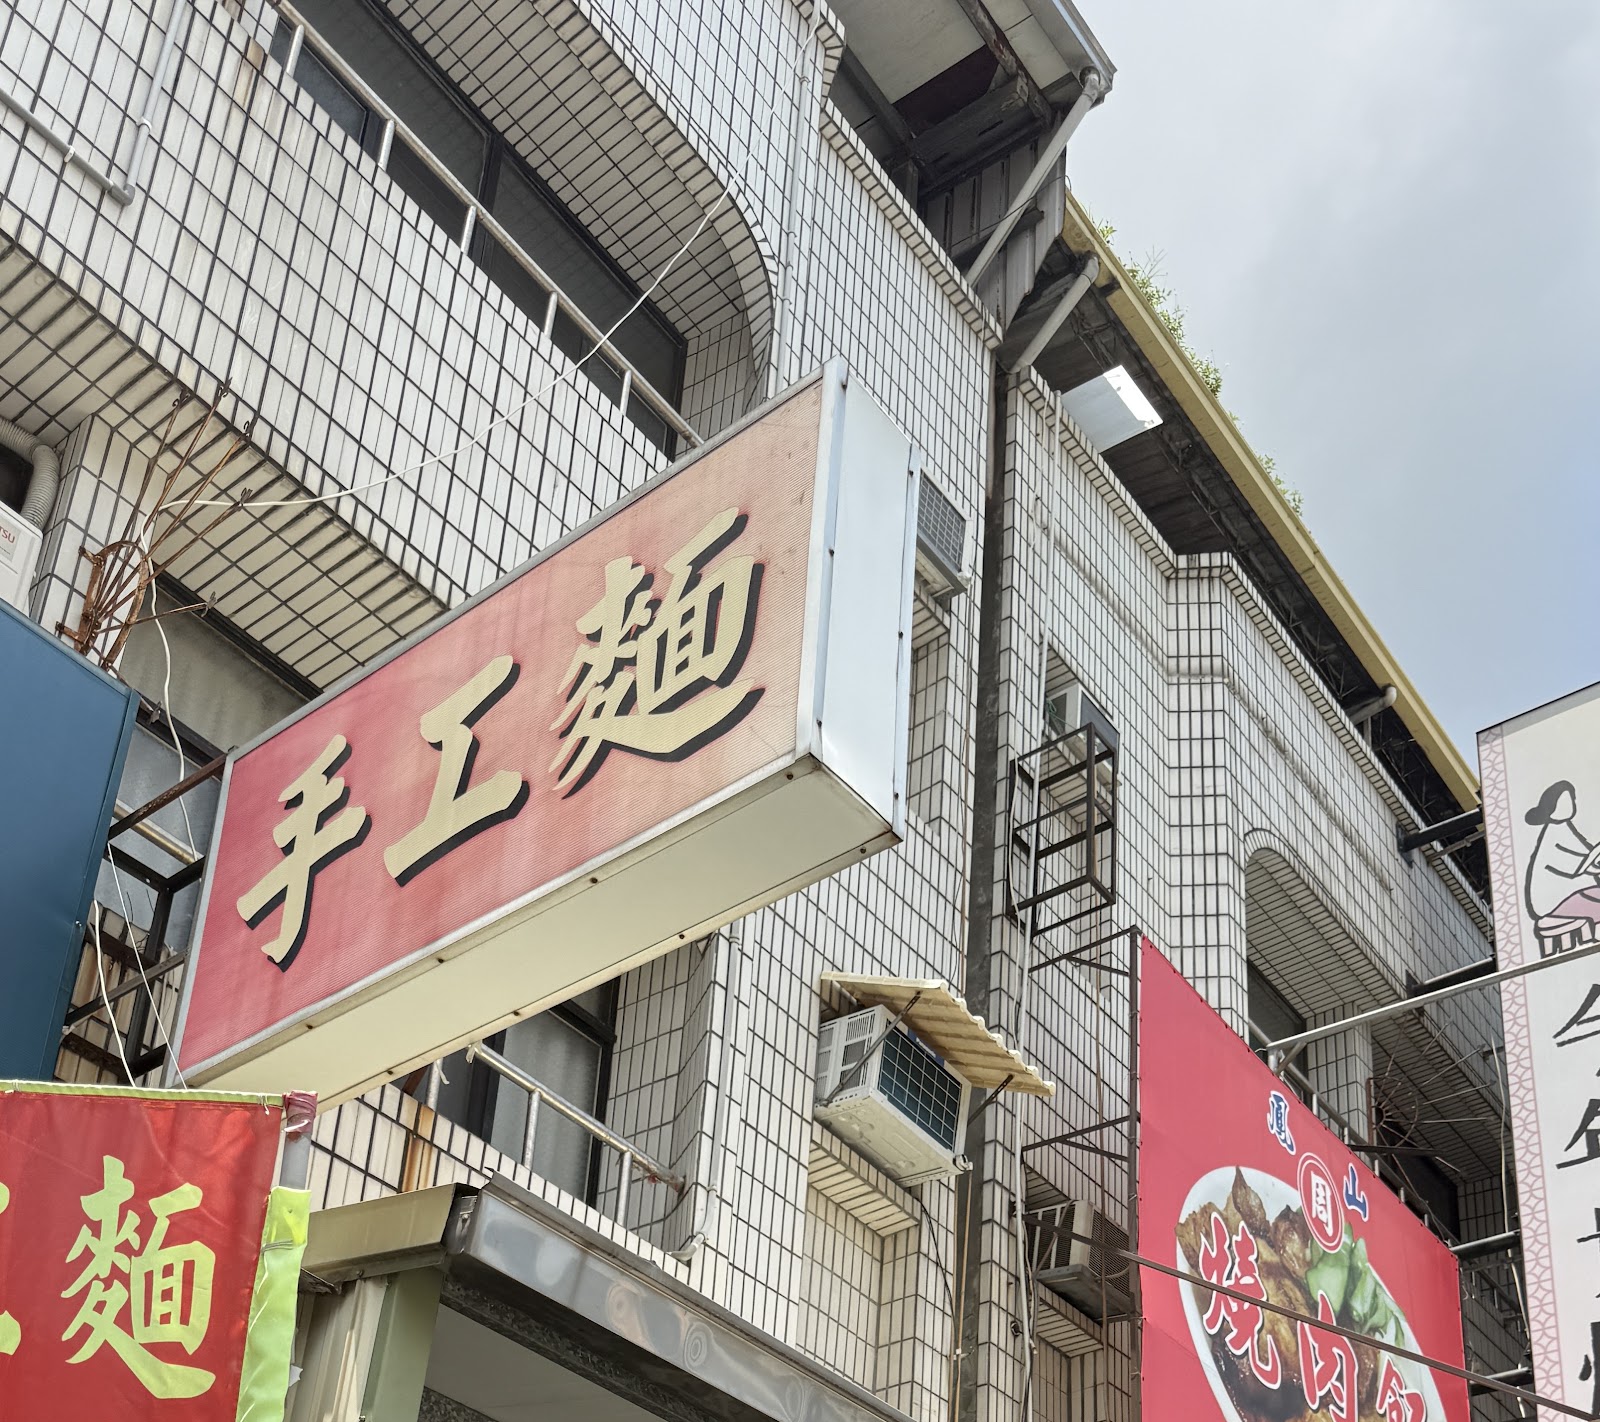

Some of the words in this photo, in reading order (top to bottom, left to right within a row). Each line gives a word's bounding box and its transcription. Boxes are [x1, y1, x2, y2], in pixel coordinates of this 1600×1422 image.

[236, 507, 766, 972] 手工麵
[0, 1155, 216, 1400] 麵
